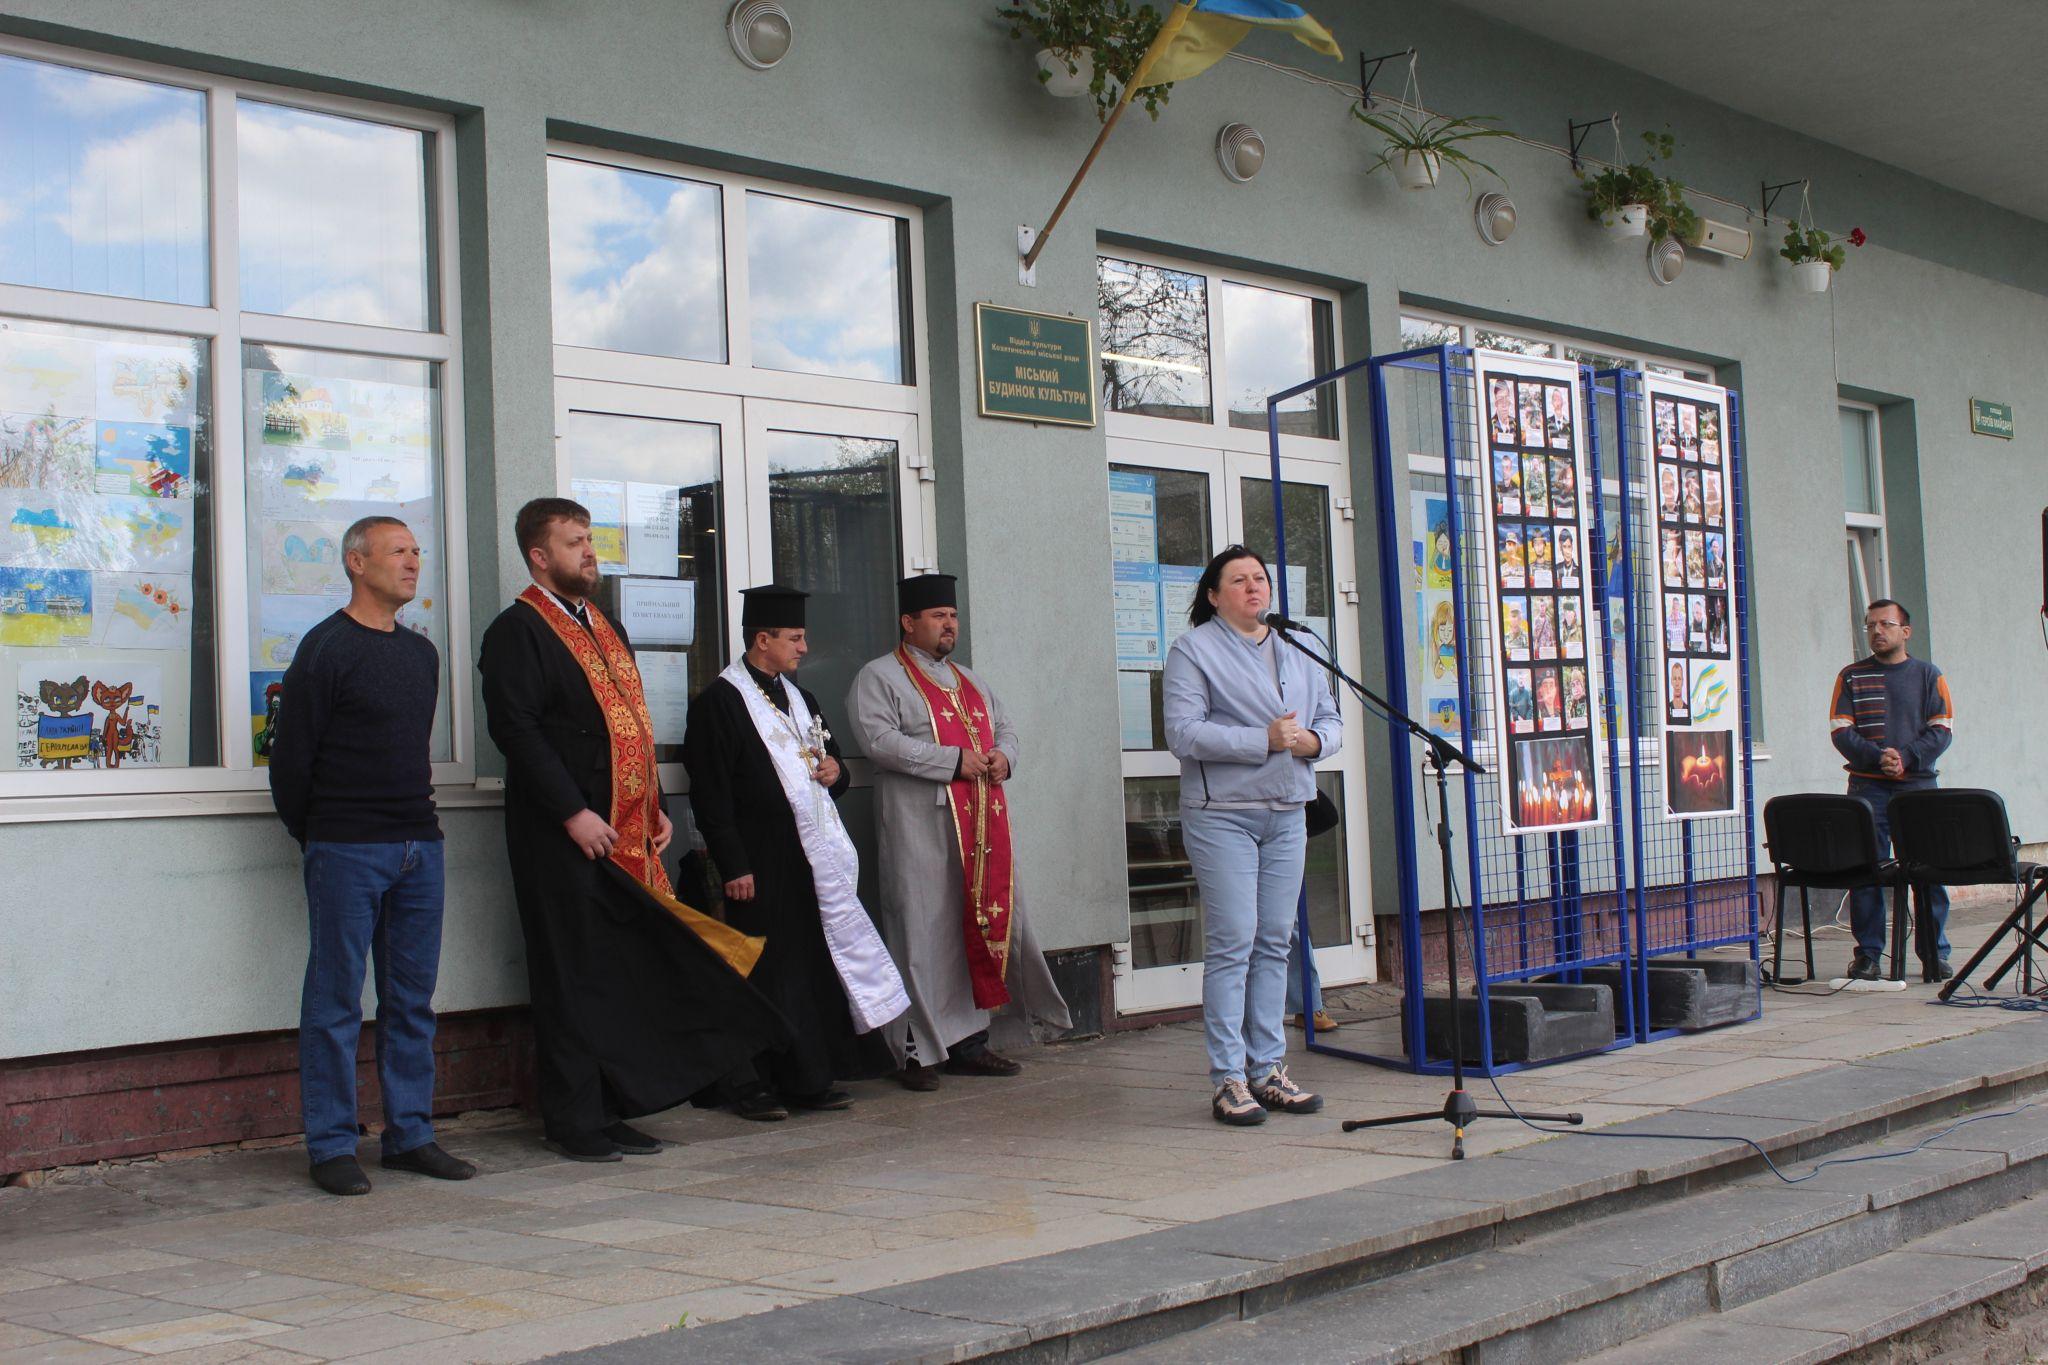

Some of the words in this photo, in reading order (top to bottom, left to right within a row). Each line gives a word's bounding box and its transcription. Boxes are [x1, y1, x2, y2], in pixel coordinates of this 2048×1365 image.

[1032, 341, 1062, 351] культури
[1015, 366, 1059, 384] МІСЬКИЙ
[989, 380, 1035, 399] БУДИНОК
[1038, 387, 1087, 405] КУЛЬТУРИ
